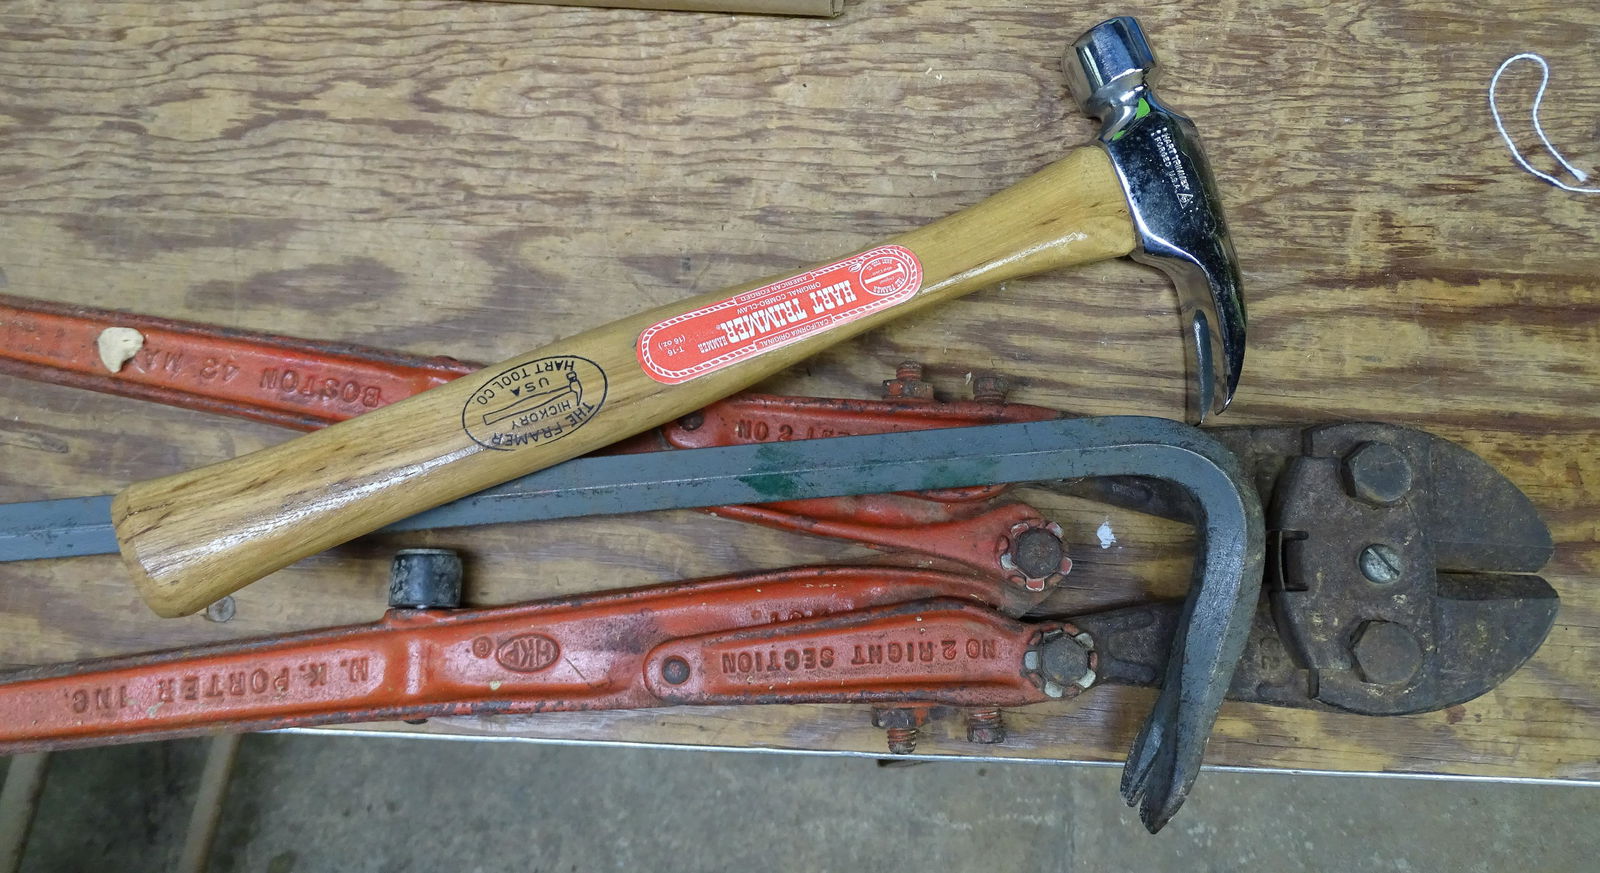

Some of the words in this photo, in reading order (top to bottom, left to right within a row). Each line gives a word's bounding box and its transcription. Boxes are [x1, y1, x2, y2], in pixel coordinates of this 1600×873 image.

[1154, 136, 1172, 168] FORGED
[740, 288, 770, 302] FORGED
[771, 276, 808, 291] AMERICAN
[788, 281, 821, 297] ORIGINAL
[736, 293, 787, 315] COMBO-CLAW
[809, 280, 857, 314] HART
[760, 332, 791, 347] ORIGINAL
[792, 318, 829, 337] CALIFORNIA
[667, 345, 685, 357] T-16
[673, 335, 686, 346] (16
[697, 335, 729, 354] HAMMER
[200, 357, 240, 383] 42
[492, 367, 531, 390] TOOL
[535, 360, 575, 375] HART
[259, 367, 382, 408] BOSTON
[511, 400, 572, 430] HICKORY
[565, 401, 595, 428] THE
[491, 422, 564, 447] FRAMER
[736, 419, 770, 442] NO
[779, 424, 794, 442] 2
[502, 637, 555, 668] HKP
[722, 645, 836, 674] SECTION
[850, 641, 933, 666] RIGHT
[941, 639, 957, 661] 2
[965, 638, 998, 660] NO
[300, 661, 327, 688] K.
[340, 656, 369, 683] H.
[158, 666, 290, 703] PORTER
[64, 685, 127, 714] INC.
